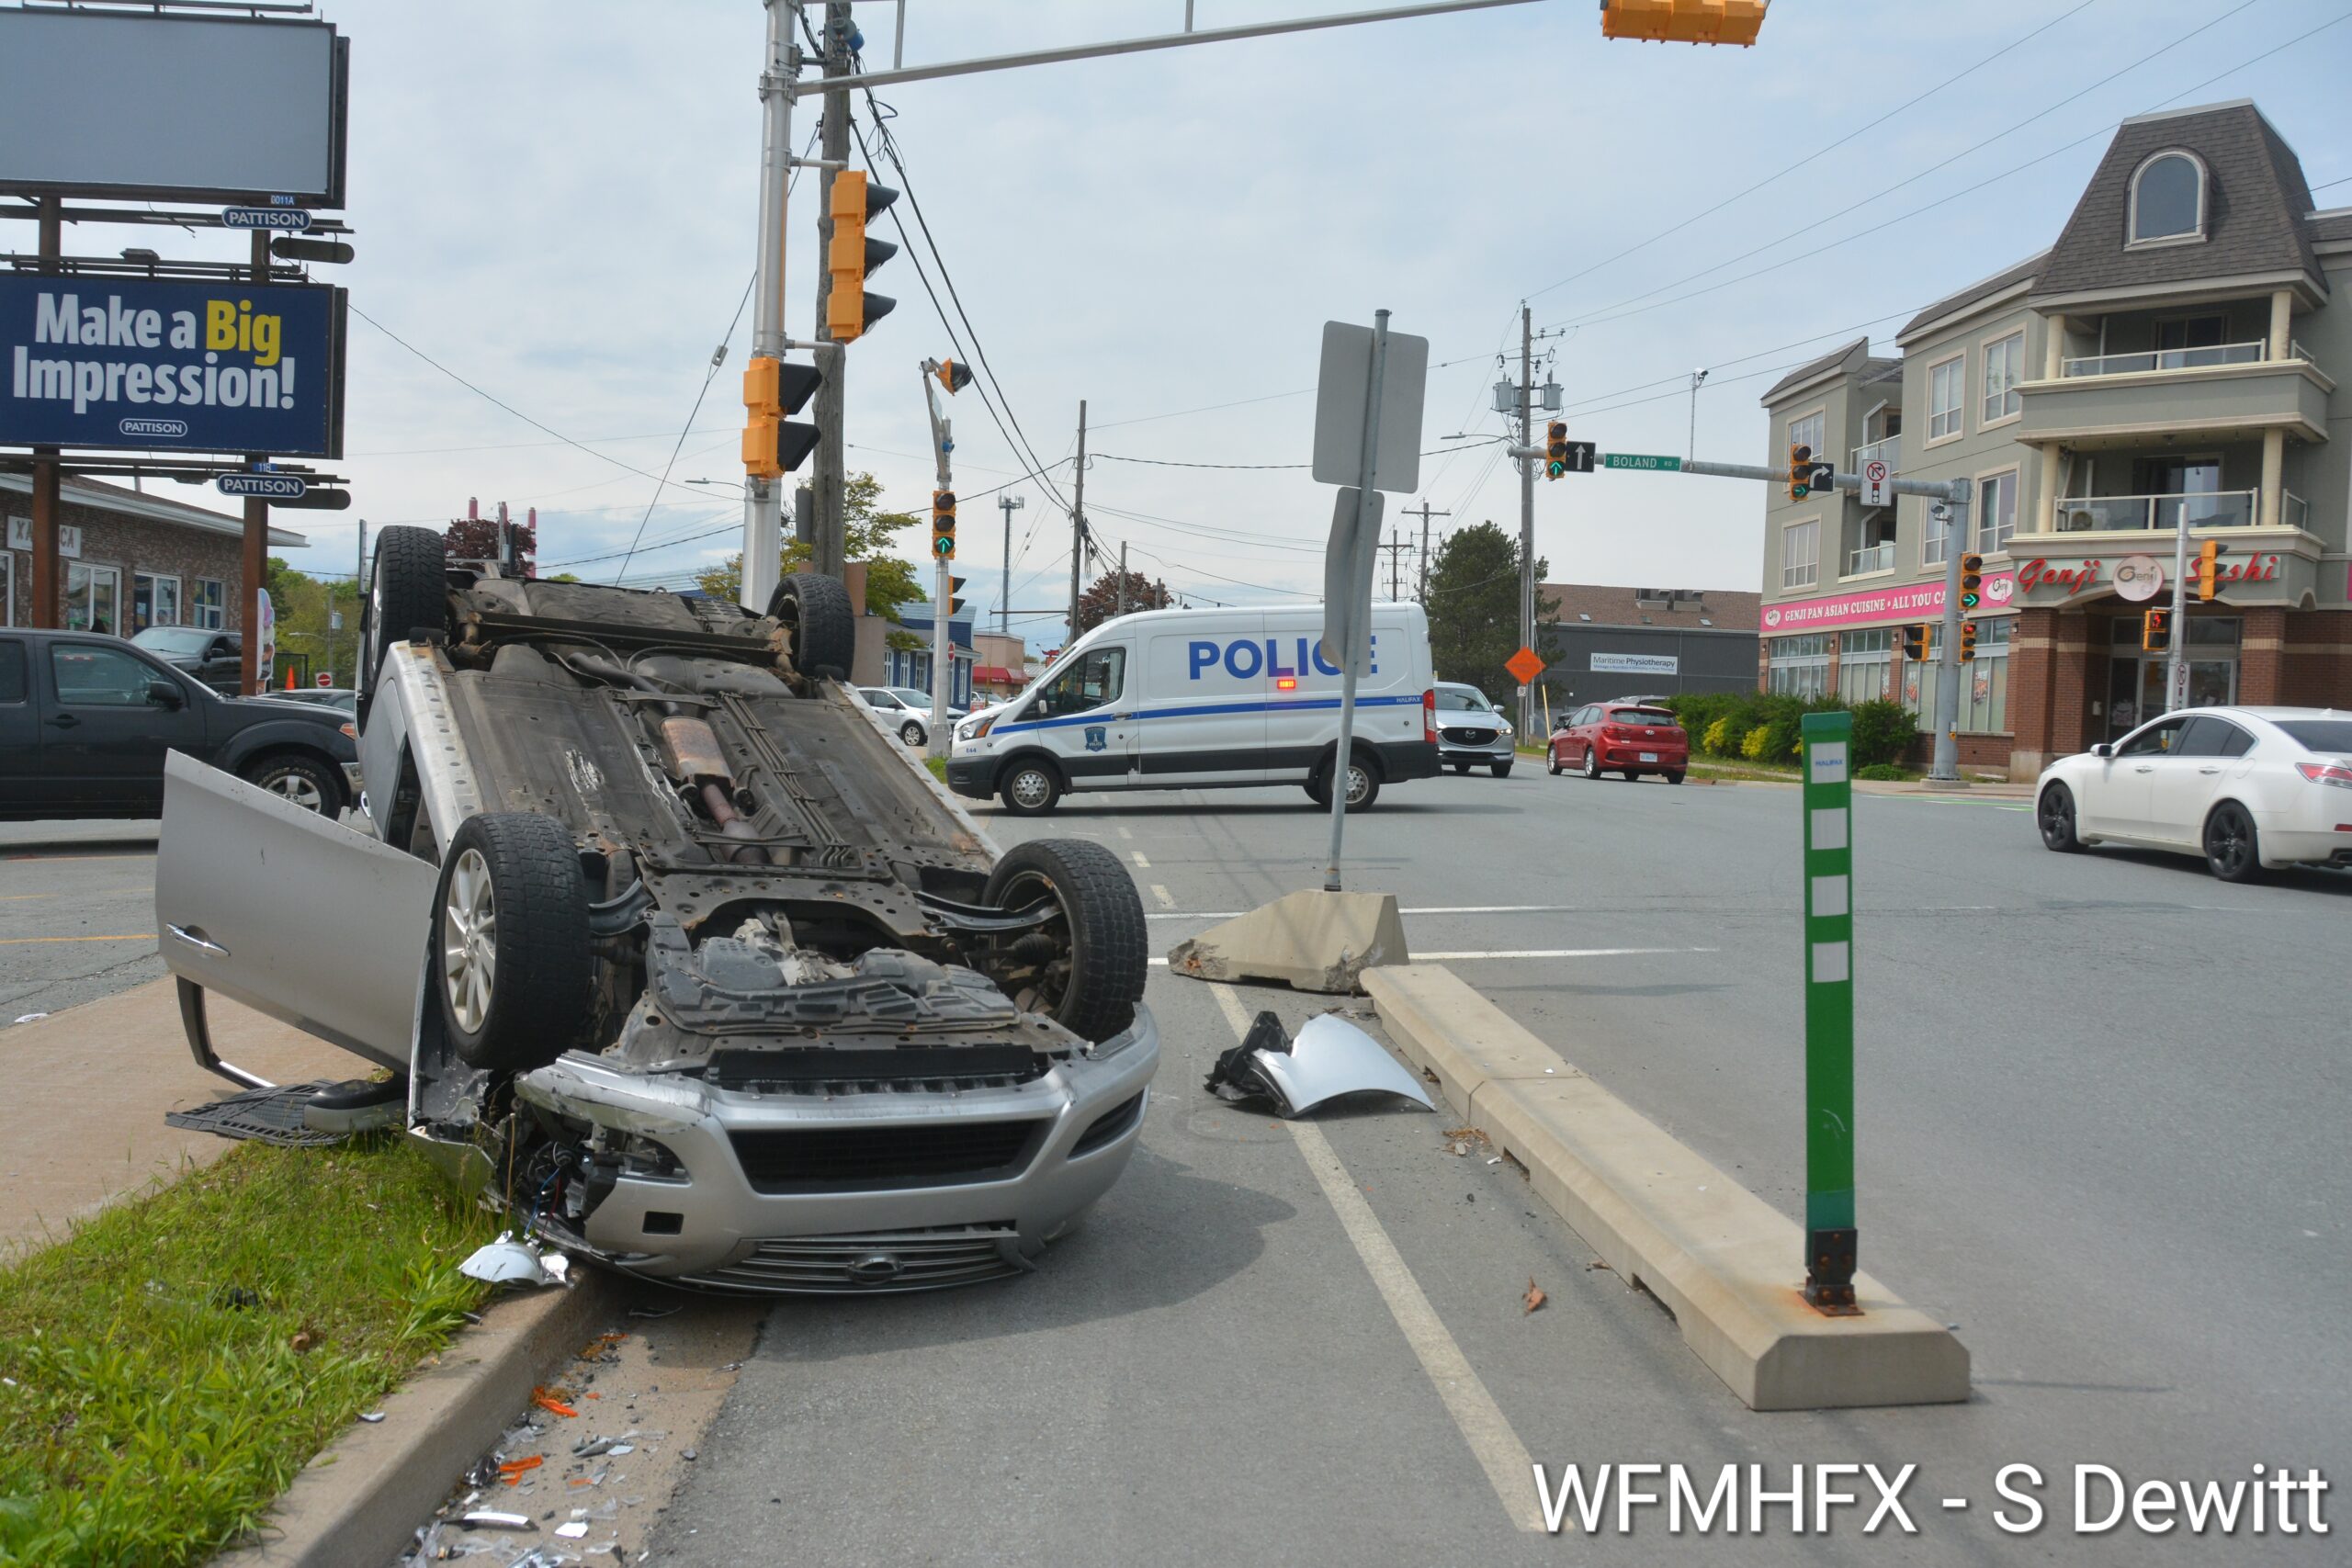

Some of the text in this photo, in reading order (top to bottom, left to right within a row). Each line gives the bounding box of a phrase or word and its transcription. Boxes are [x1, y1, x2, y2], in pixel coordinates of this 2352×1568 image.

[229, 212, 304, 226] PATTISON
[35, 292, 281, 367] Make a Big
[13, 345, 295, 414] Impression!
[125, 423, 182, 434] PATTISON
[1613, 457, 1657, 468] BOLAND
[224, 479, 299, 493] PATTISON
[2018, 558, 2101, 595] Genji
[2185, 552, 2278, 581] Sshi
[1785, 610, 1806, 622] GENJI
[1808, 606, 1824, 619] PAN
[1825, 603, 1849, 617] ASIAN
[1850, 599, 1886, 615] CUISINE
[1892, 595, 1910, 610] ALL
[1911, 592, 1932, 607] YOU
[1189, 635, 1378, 680] POLIC
[1593, 656, 1624, 664] Maritime
[1626, 658, 1676, 668] Physiotherapy
